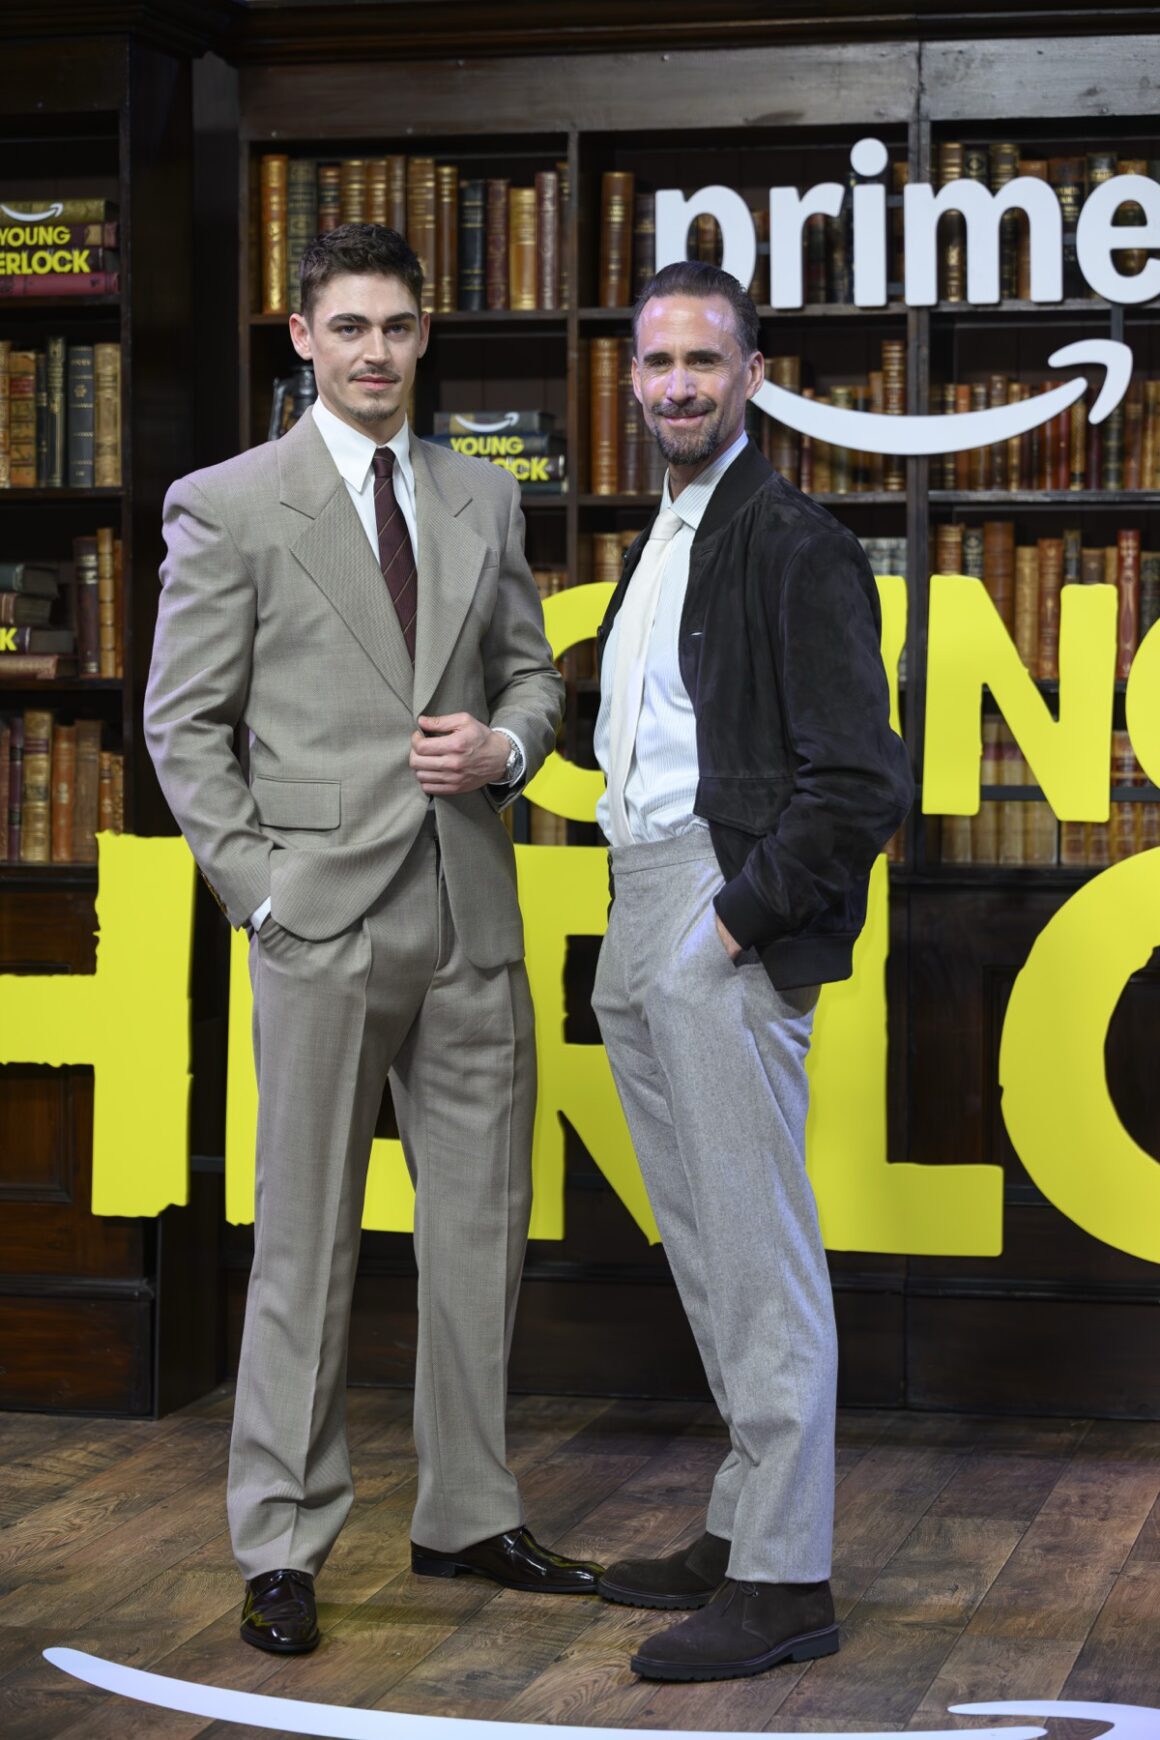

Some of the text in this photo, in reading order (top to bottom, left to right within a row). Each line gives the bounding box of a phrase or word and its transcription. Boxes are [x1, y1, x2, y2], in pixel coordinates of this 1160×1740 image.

[655, 138, 1160, 309] prime
[0, 225, 71, 247] YOUNG
[450, 436, 525, 456] YOUNG
